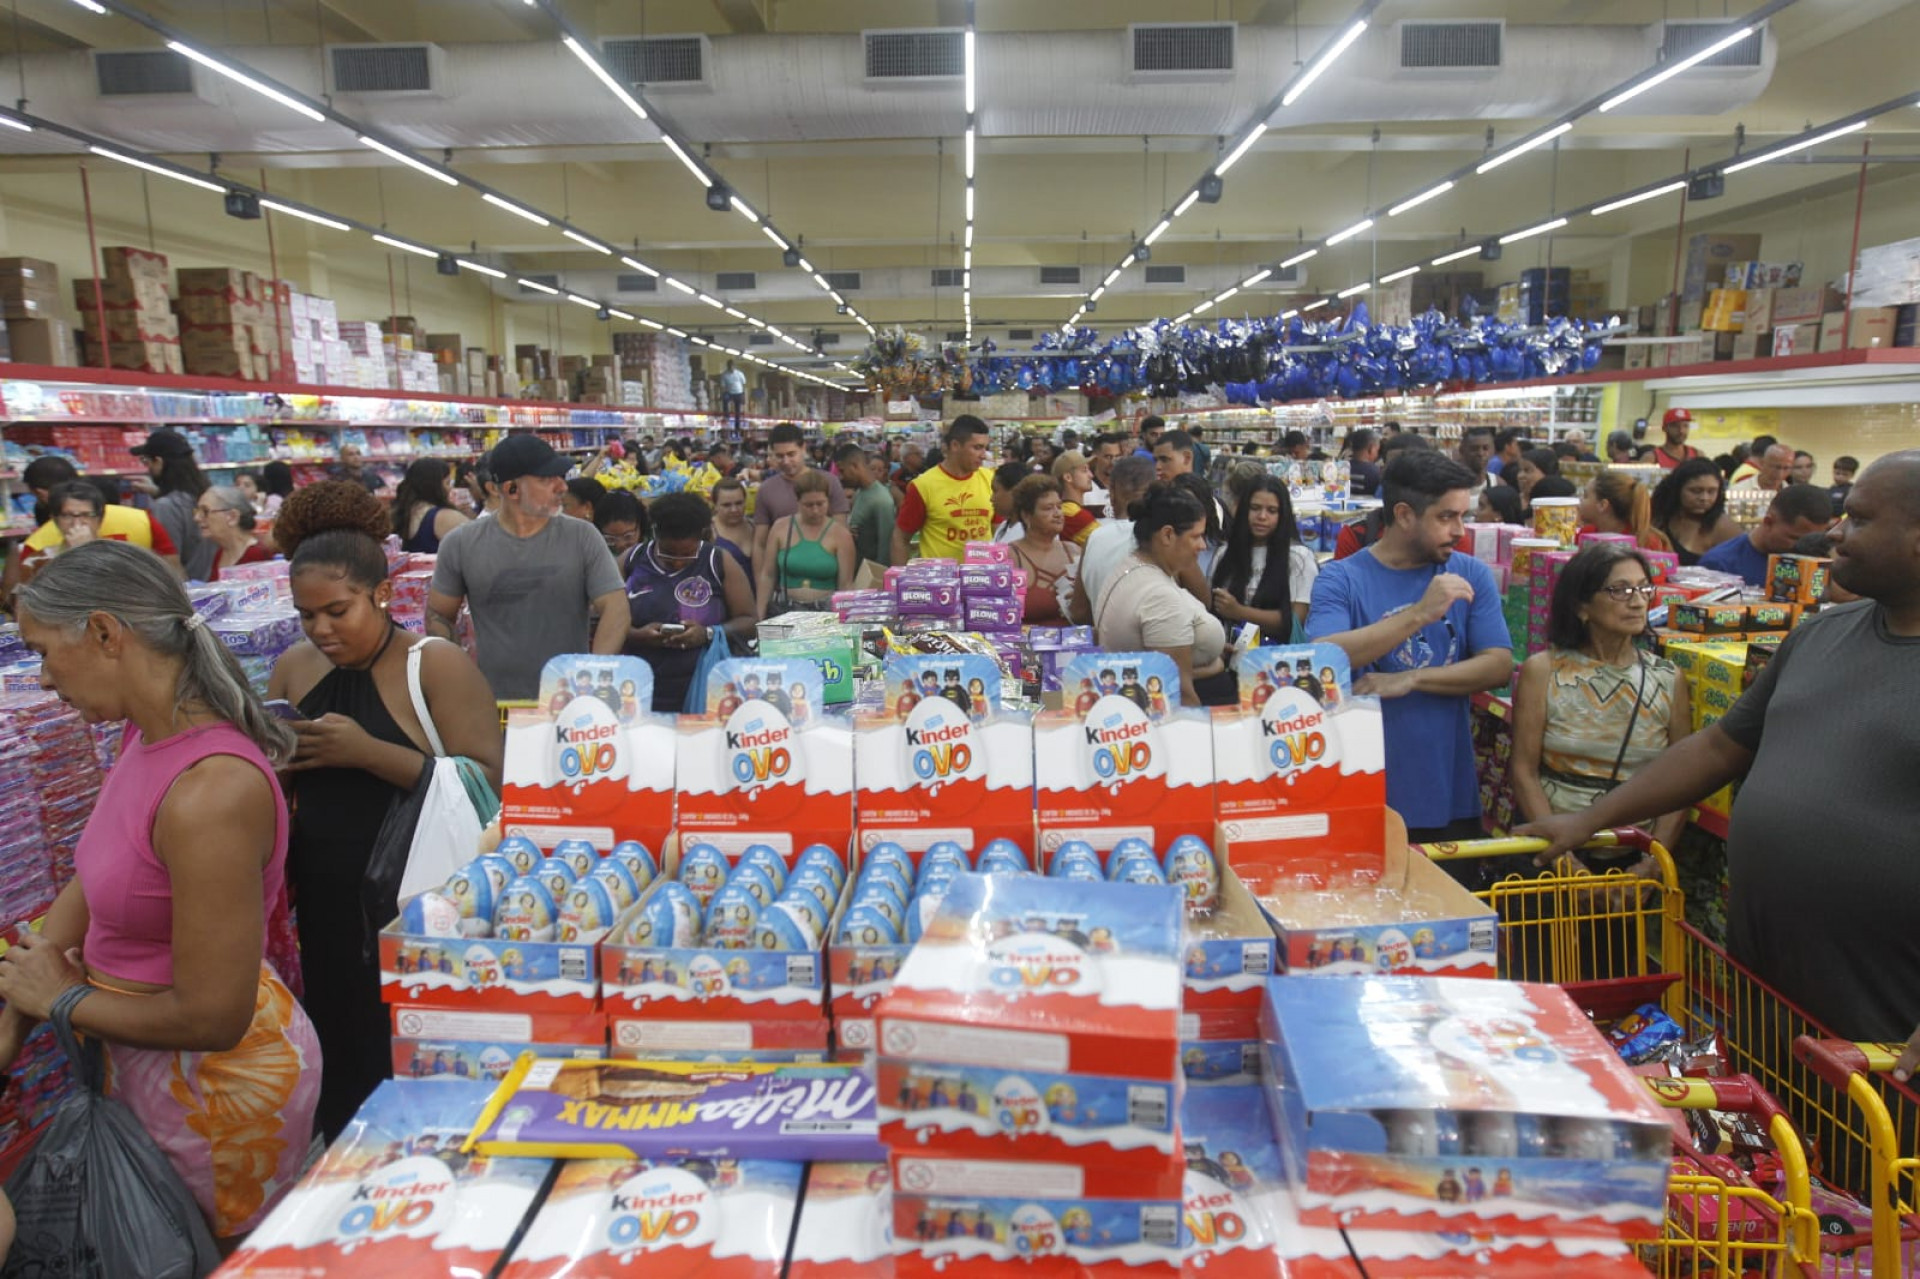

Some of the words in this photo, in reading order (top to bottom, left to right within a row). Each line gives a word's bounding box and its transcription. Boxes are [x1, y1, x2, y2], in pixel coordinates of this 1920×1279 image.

[560, 743, 617, 777] OVO
[733, 747, 791, 783] OVO
[913, 743, 972, 779] OVO
[1093, 741, 1152, 778] OVO
[1270, 731, 1326, 769] OVO
[468, 967, 498, 984] OVO
[989, 967, 1081, 987] OVO
[556, 1100, 700, 1131] MMMAX
[695, 1076, 875, 1130] Milka
[999, 1107, 1040, 1131] OVO
[338, 1199, 434, 1236] OVO
[607, 1209, 700, 1245] OVO
[1711, 1221, 1757, 1235] TENTO
[1015, 1231, 1056, 1255] OVO
